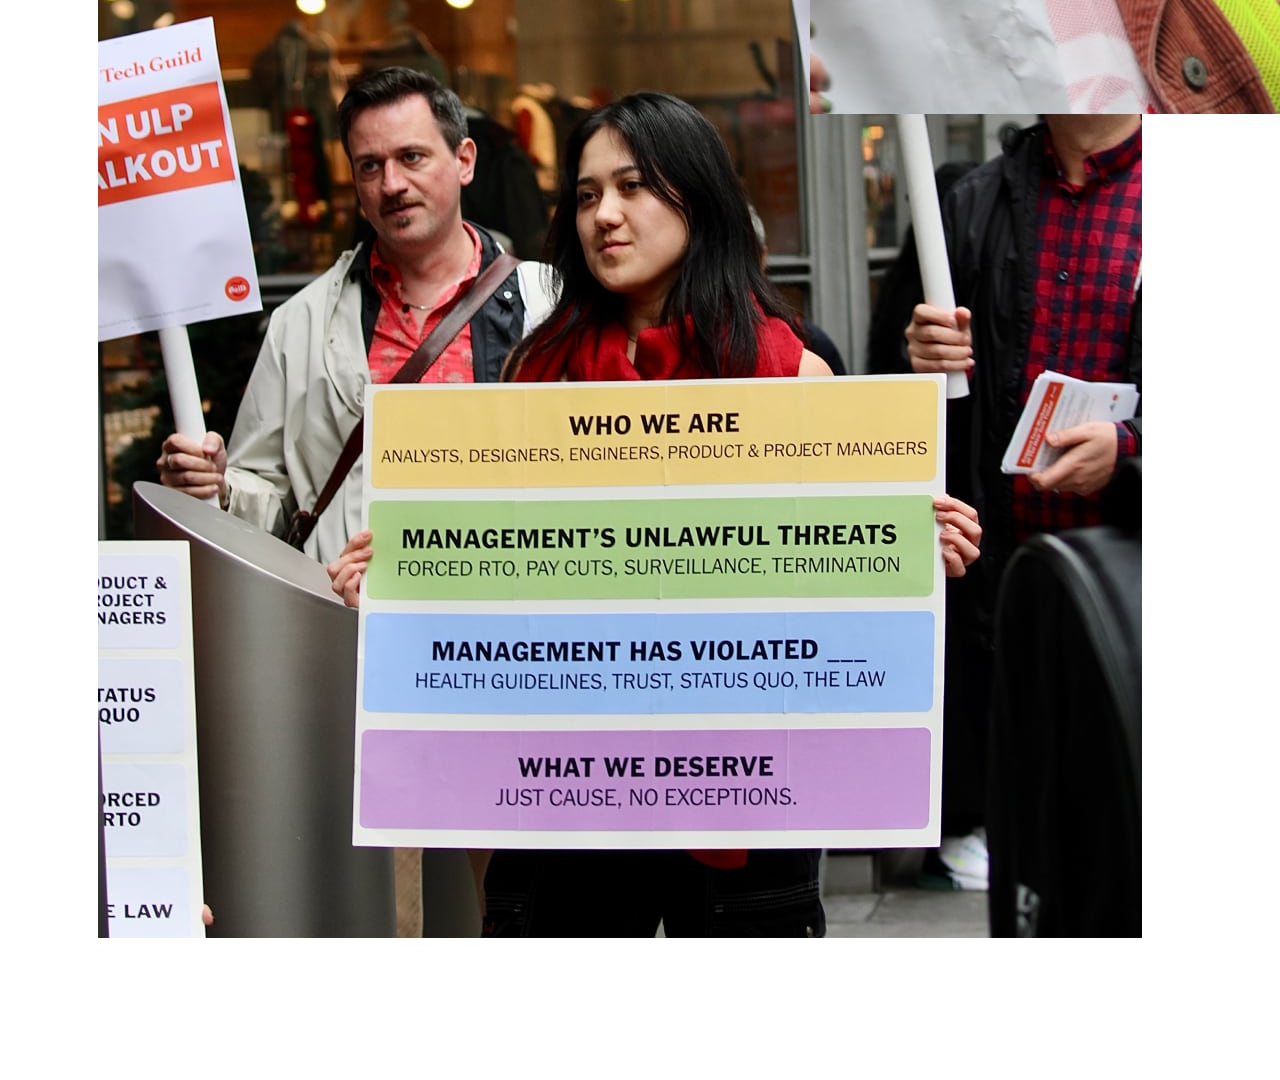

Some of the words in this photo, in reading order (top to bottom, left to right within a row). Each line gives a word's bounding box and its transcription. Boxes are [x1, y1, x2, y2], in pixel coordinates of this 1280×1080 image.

[101, 62, 145, 83] Tech
[149, 47, 203, 73] Guild
[125, 103, 193, 140] ULP
[569, 415, 631, 436] WHO
[641, 414, 680, 434] WE
[688, 413, 740, 433] ARE
[381, 449, 463, 464] ANALYSTS,
[469, 448, 564, 463] DESIGNERS,
[569, 446, 664, 461] ENGINEERS,
[668, 444, 744, 459] PRODUCT
[748, 444, 760, 457] &
[763, 443, 832, 458] PROJECT
[836, 441, 928, 456] MANAGERS
[625, 526, 770, 547] UNLAWFUL
[777, 524, 897, 546] THREATS
[397, 560, 473, 577] FORCED
[479, 560, 520, 578] RTO,
[526, 559, 560, 576] PAY
[564, 559, 618, 577] CUTS,
[624, 558, 767, 576] SURVEILLANCE,
[771, 556, 900, 574] TERMINATION
[154, 576, 167, 589] &
[432, 641, 621, 662] MANAGEMENT
[630, 640, 682, 661] HAS
[690, 639, 818, 661] VIOLATED
[415, 672, 485, 689] HEALTH
[491, 672, 608, 691] GUIDELINES,
[612, 672, 674, 691] TRUST,
[680, 672, 749, 689] STATUS
[753, 671, 799, 690] QUO,
[803, 671, 840, 687] THE
[846, 671, 886, 687] LAW
[99, 708, 140, 724] QUO
[518, 757, 596, 778] WHAT
[604, 757, 645, 777] WE
[655, 756, 774, 777] DESERVE
[495, 788, 544, 806] JUST
[549, 788, 622, 808] CAUSE,
[630, 788, 658, 806] NO
[665, 787, 798, 806] EXCEPTIONS.
[104, 812, 141, 826] RTO
[124, 904, 173, 918] LAW
